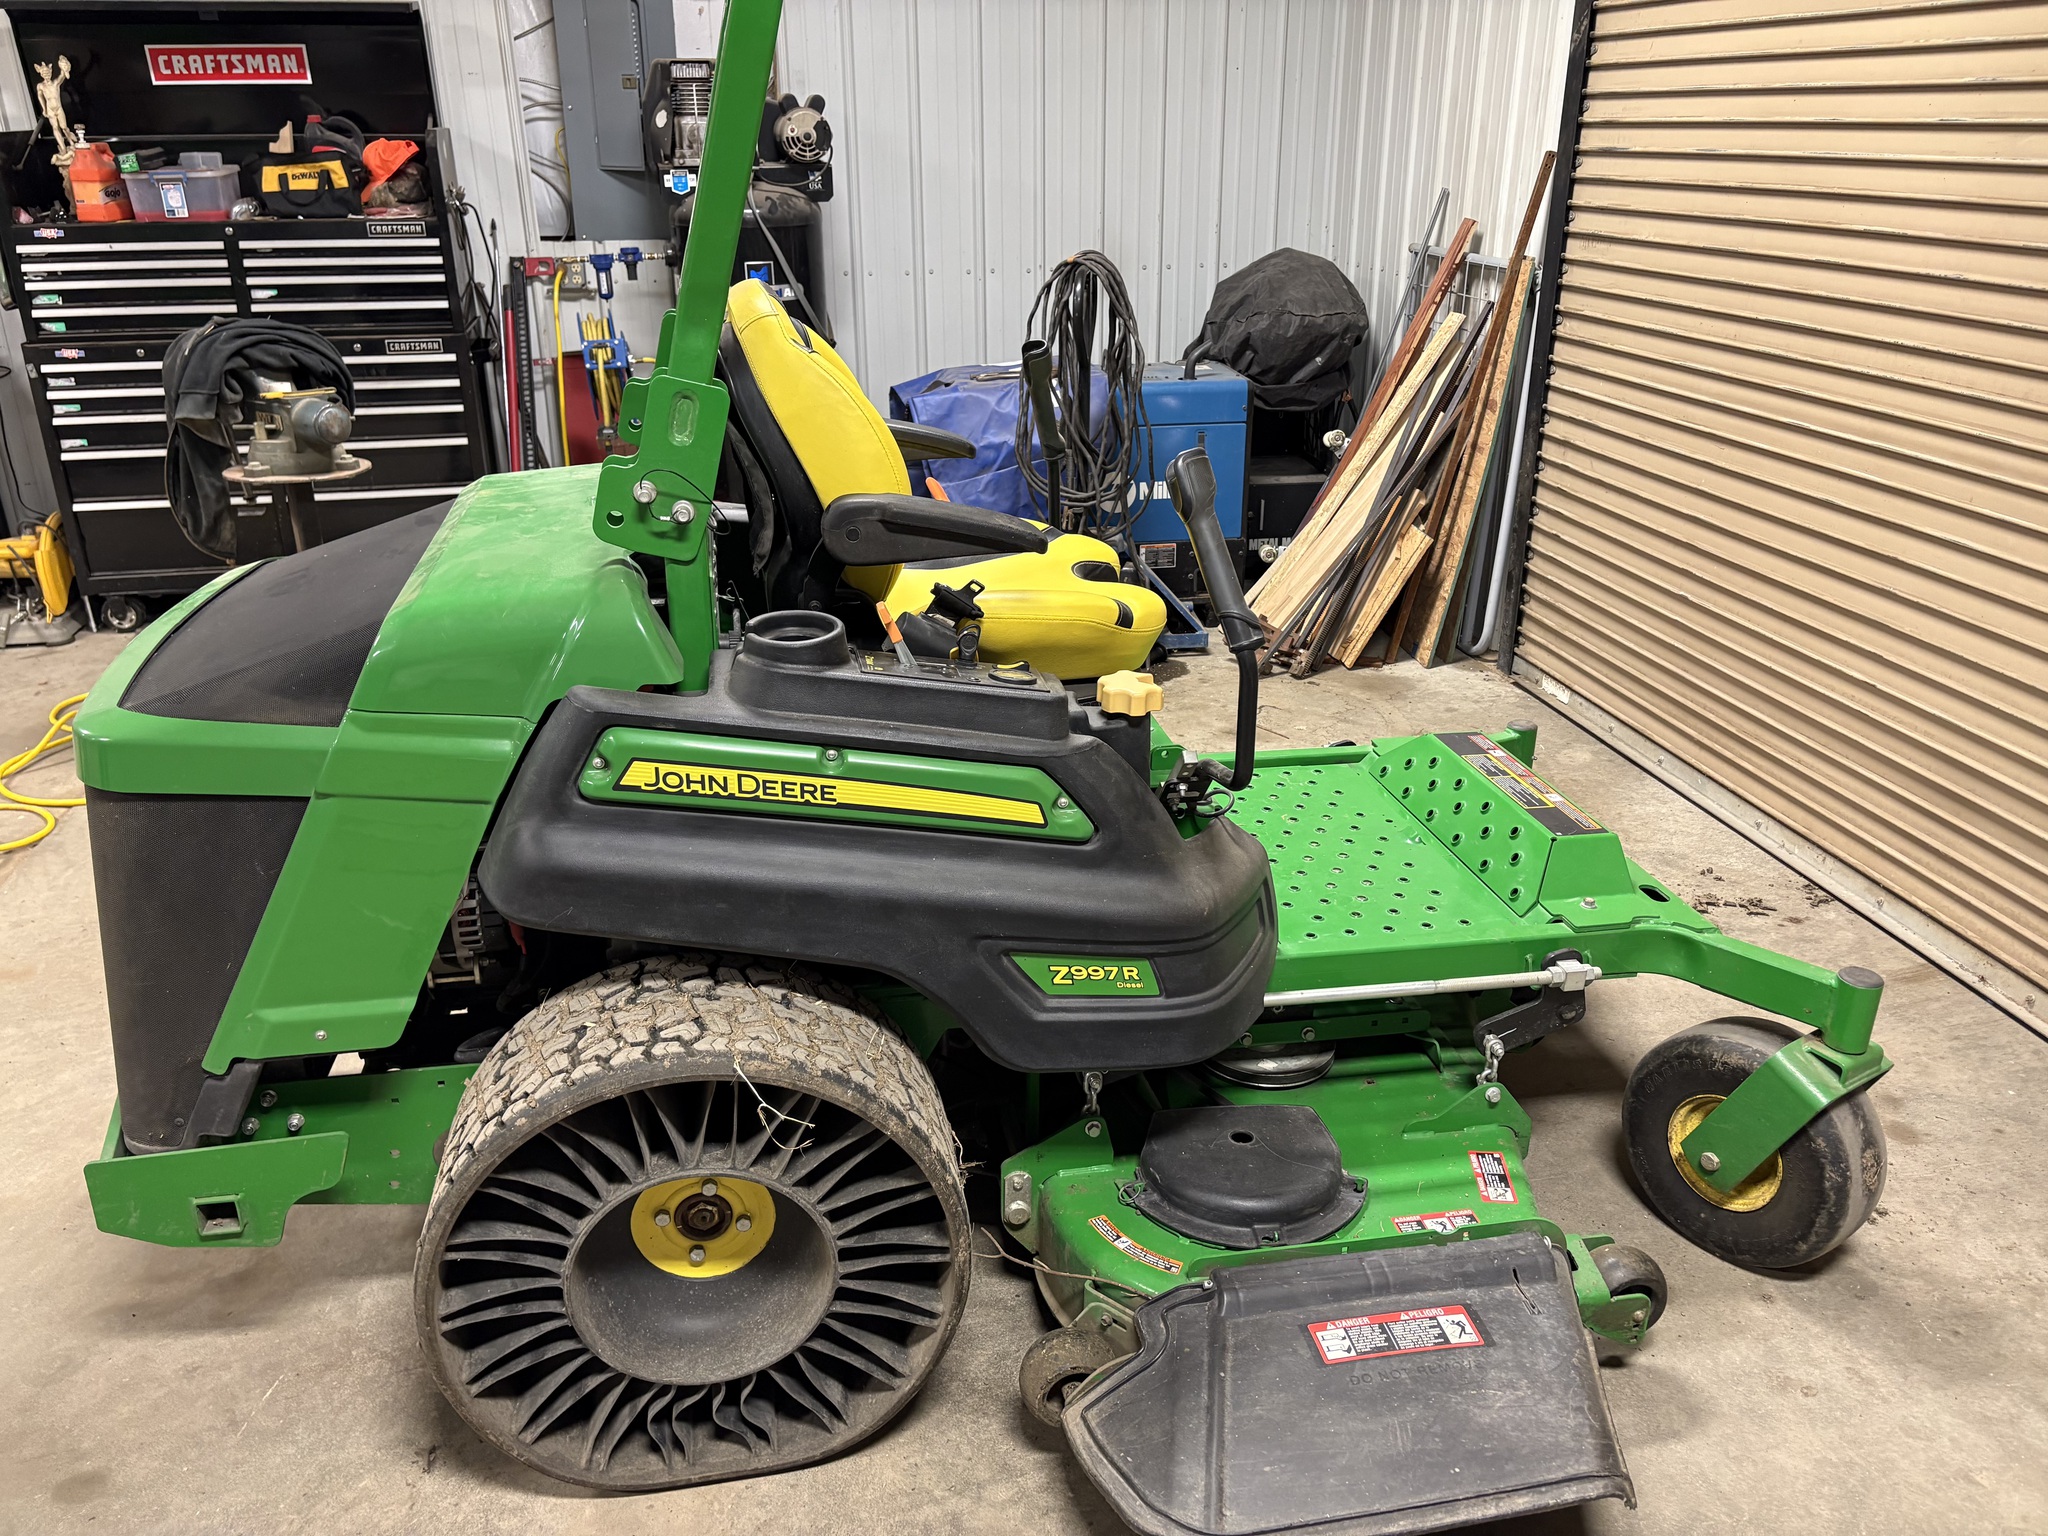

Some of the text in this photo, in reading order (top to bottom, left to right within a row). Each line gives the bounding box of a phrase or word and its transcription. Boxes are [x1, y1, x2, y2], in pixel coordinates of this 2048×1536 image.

[157, 54, 299, 75] CRAFTSMAN
[809, 181, 823, 190] USA
[371, 225, 422, 234] CRAFTSMAN
[389, 341, 440, 351] CRAFTSMAN
[643, 766, 838, 802] JOHN DEERE
[1048, 965, 1141, 986] Z997R
[1116, 981, 1144, 989] Diesel
[1335, 1307, 1445, 1329] DANGER PELIGRO
[1349, 1373, 1373, 1386] DO
[1377, 1367, 1410, 1382] NOT
